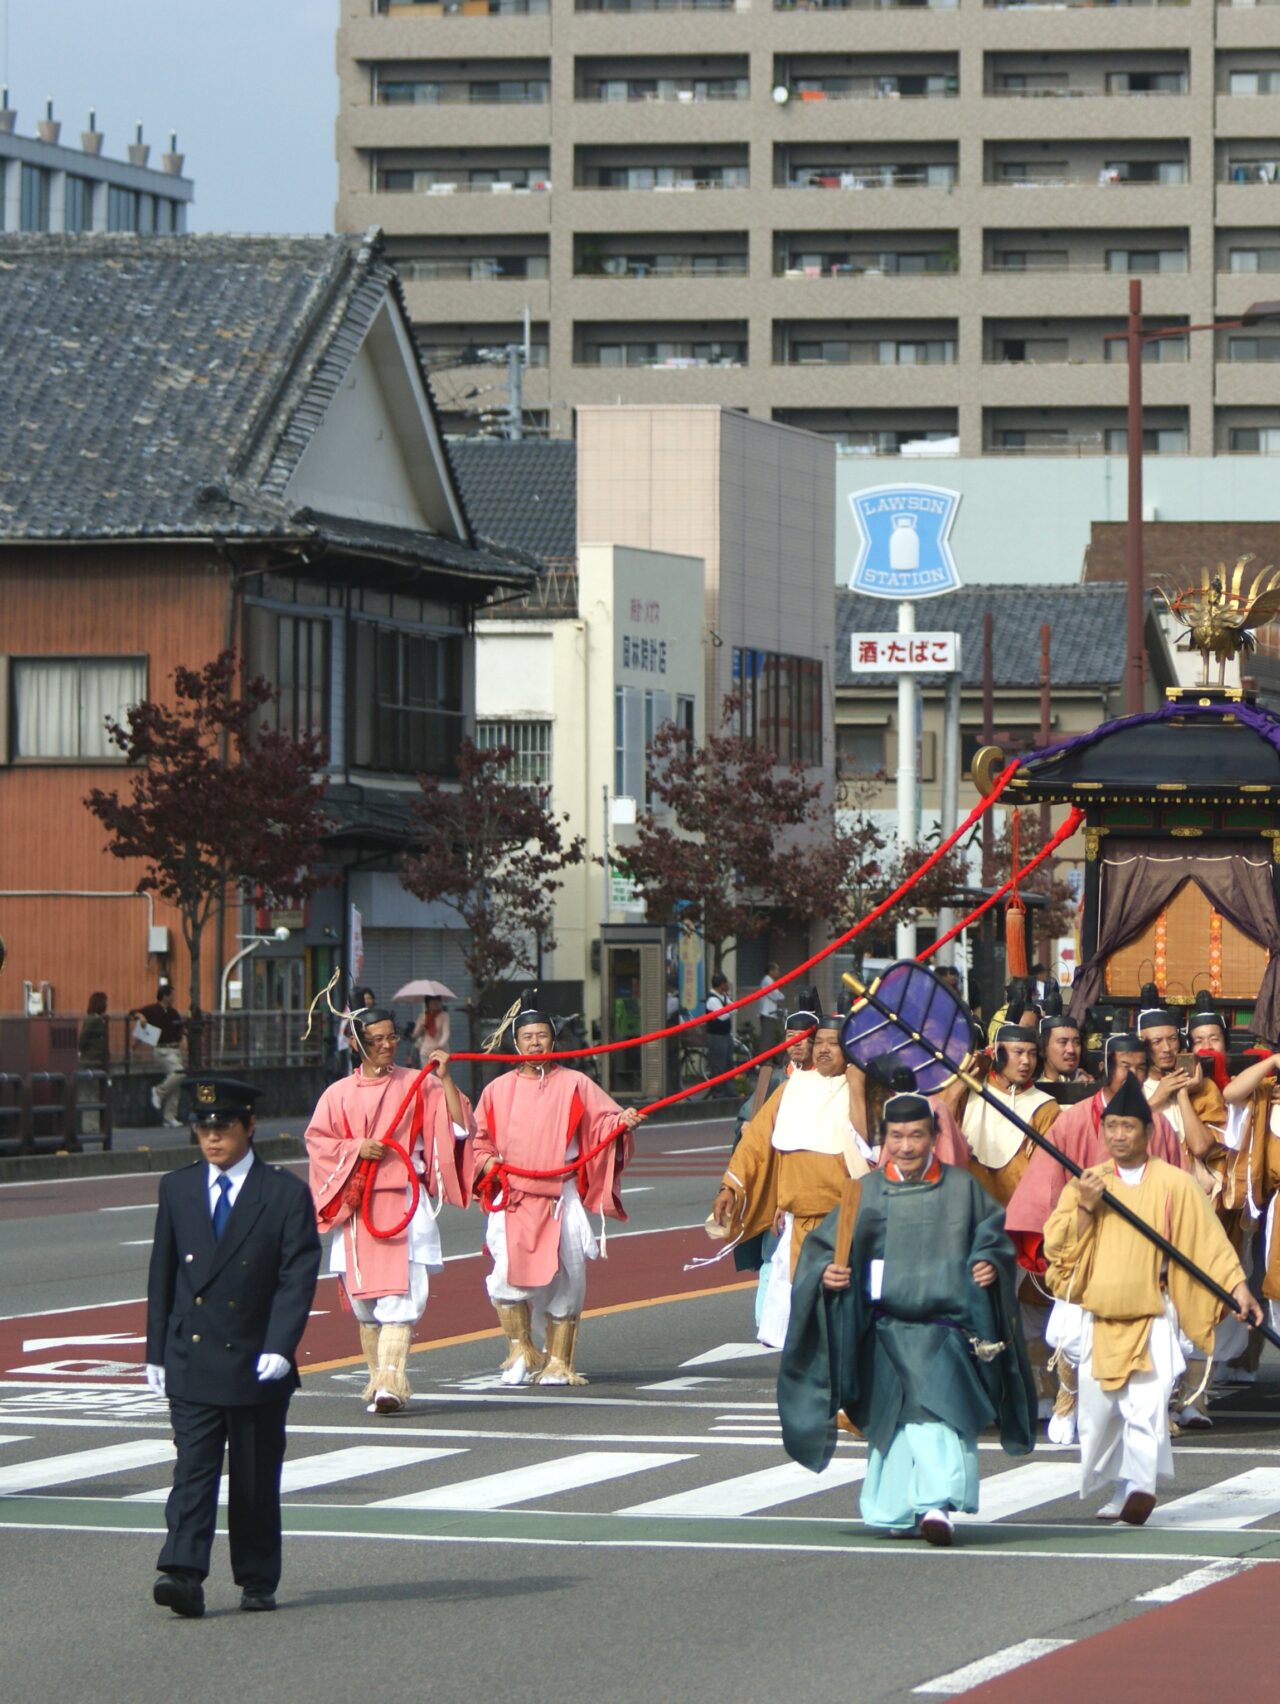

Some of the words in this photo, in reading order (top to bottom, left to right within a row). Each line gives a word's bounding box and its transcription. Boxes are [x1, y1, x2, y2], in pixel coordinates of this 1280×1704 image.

[864, 497, 945, 515] LAWSON
[864, 568, 945, 587] STATION
[858, 641, 948, 663] 酒・たばこ
